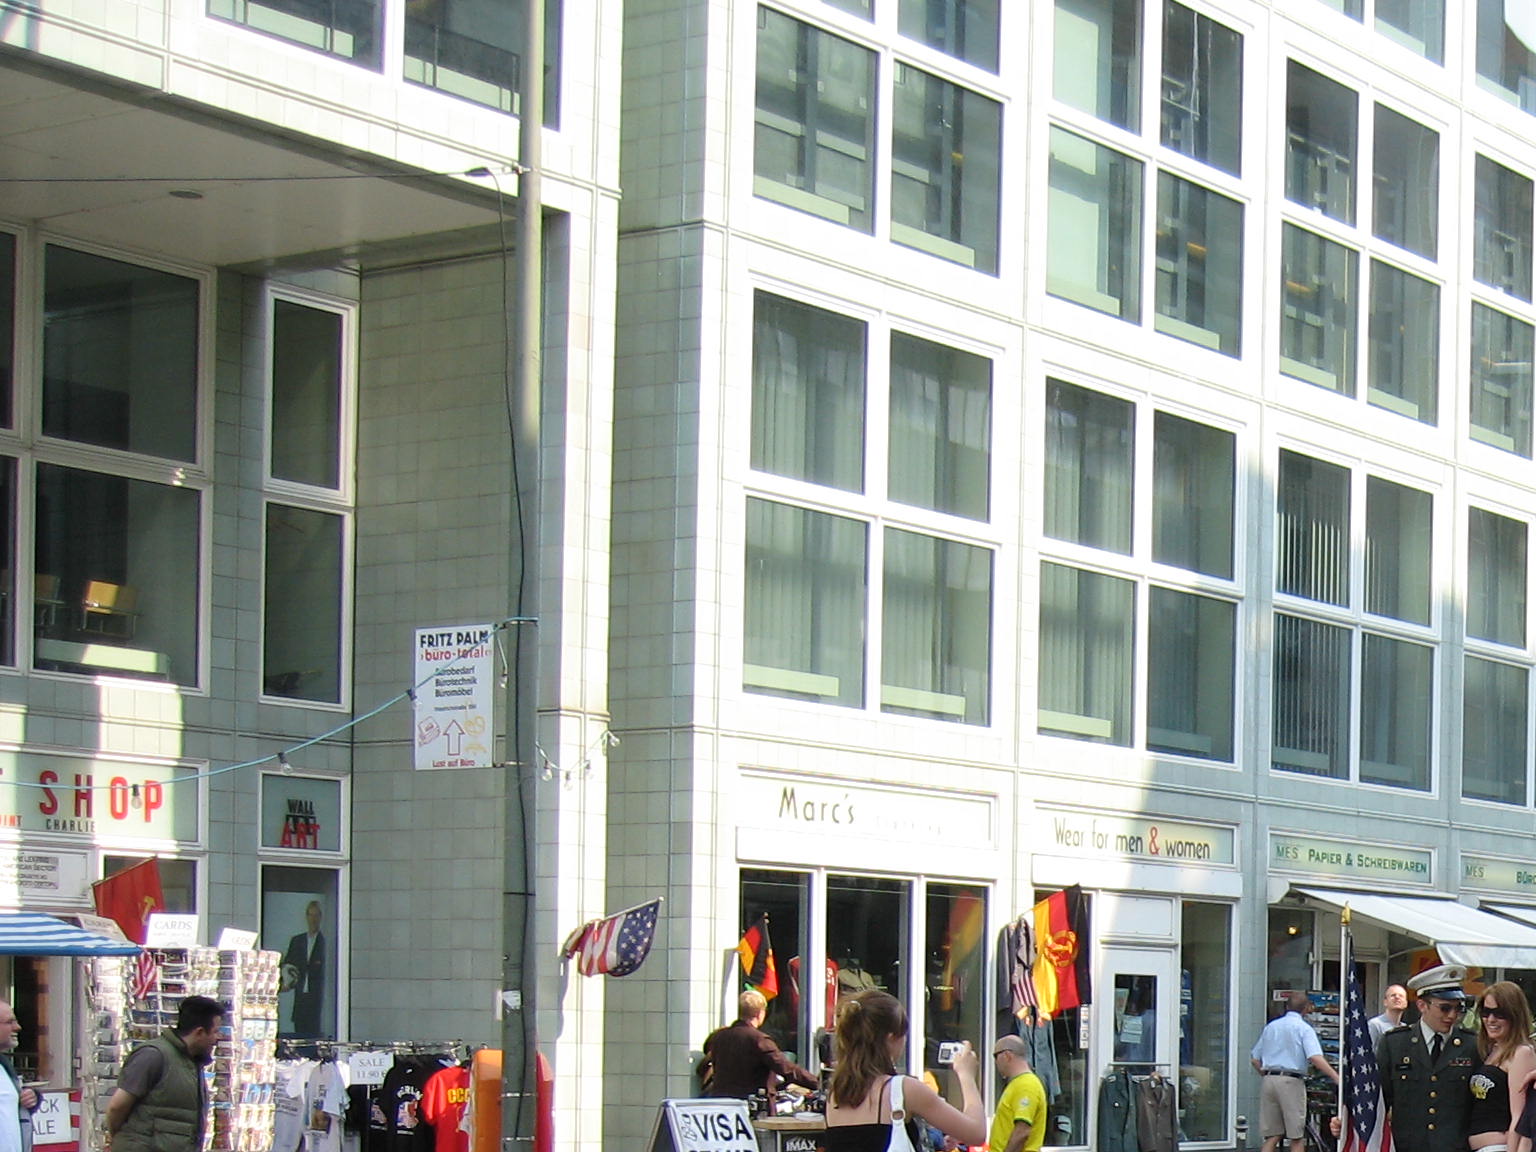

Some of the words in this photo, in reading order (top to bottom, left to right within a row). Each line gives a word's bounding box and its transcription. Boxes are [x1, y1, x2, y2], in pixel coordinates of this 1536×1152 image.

[420, 632, 453, 649] FRITZ
[456, 630, 489, 644] PALM
[39, 770, 163, 823] SHOP
[0, 815, 22, 827] INT
[46, 819, 96, 832] CHARLIE
[1054, 817, 1084, 847] Wear
[1092, 819, 1109, 849] for
[1115, 834, 1143, 853] men
[1149, 826, 1160, 855] &
[1165, 839, 1210, 859] women
[1276, 845, 1299, 859] MES
[1345, 852, 1353, 866] &
[1465, 865, 1485, 878] MES
[359, 1058, 384, 1067] SALE
[448, 1088, 470, 1104] CCC
[693, 1113, 753, 1142] VISA
[786, 1139, 817, 1152] IMAX
